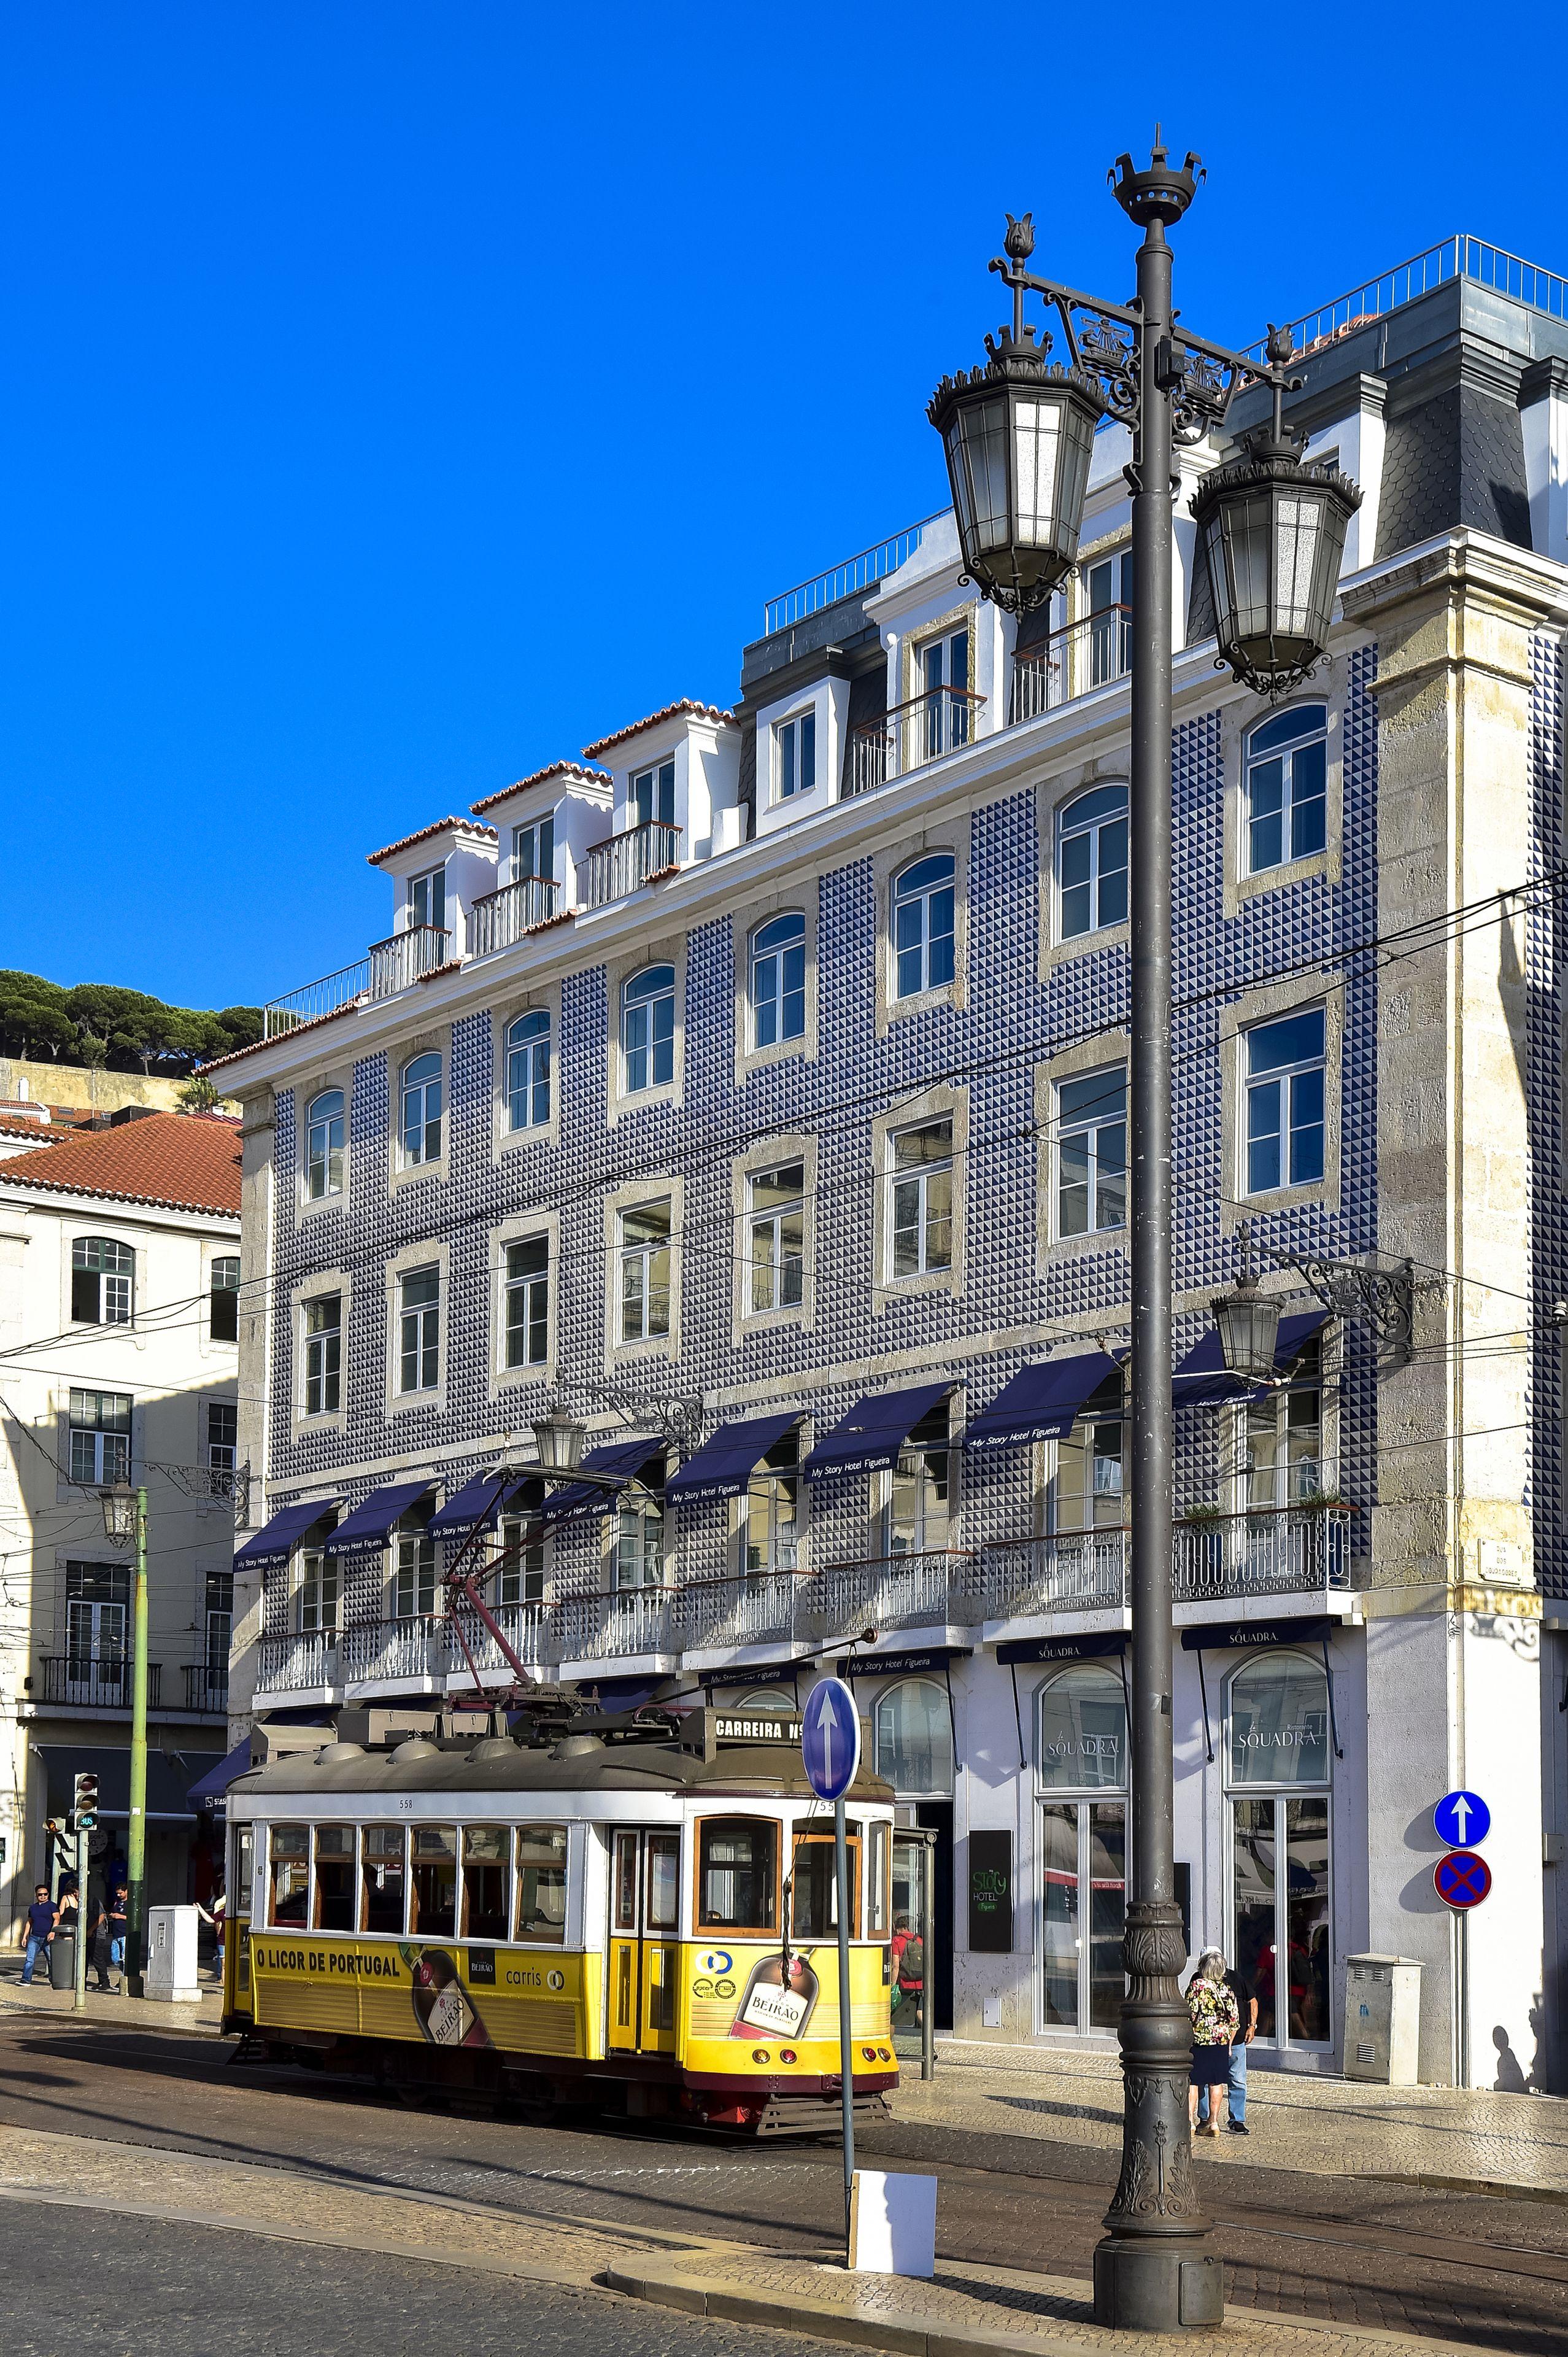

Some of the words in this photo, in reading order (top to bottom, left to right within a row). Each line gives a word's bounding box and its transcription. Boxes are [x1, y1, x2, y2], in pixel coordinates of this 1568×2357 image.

[969, 1439, 985, 1447] My
[986, 1436, 1008, 1445] Story
[1010, 1430, 1030, 1441] Hotel
[1032, 1426, 1060, 1438] Figueira
[811, 1468, 823, 1478] My
[824, 1466, 843, 1474] Story
[844, 1461, 862, 1471] Hotel
[865, 1457, 890, 1469] Figueira
[673, 1493, 683, 1503] My
[701, 1487, 716, 1496] Hotel
[718, 1484, 740, 1495] Figueira
[433, 1529, 441, 1538] My
[457, 1523, 471, 1533] Hotel
[364, 1538, 382, 1549] Figueira
[851, 1662, 863, 1673] My
[865, 1662, 883, 1671] Story
[885, 1659, 903, 1668] Hotel
[905, 1657, 930, 1668] Figueira
[716, 1719, 782, 1739] CARREIRA
[1048, 1739, 1119, 1757] SQUADRA.
[1238, 1730, 1320, 1749] SQUADRA.
[400, 1800, 413, 1809] 558
[820, 1802, 835, 1811] 55
[973, 1892, 998, 1901] HOTEL
[257, 1948, 265, 1967] O
[268, 1949, 306, 1970] LICOR
[309, 1951, 325, 1972] DE
[329, 1953, 400, 1977] PORTUGAL
[471, 1962, 493, 1973] BEIRÃO
[506, 1967, 541, 1986] carris
[752, 1996, 798, 2021] BEIRÃO
[435, 1997, 464, 2043] BEIRÃO
